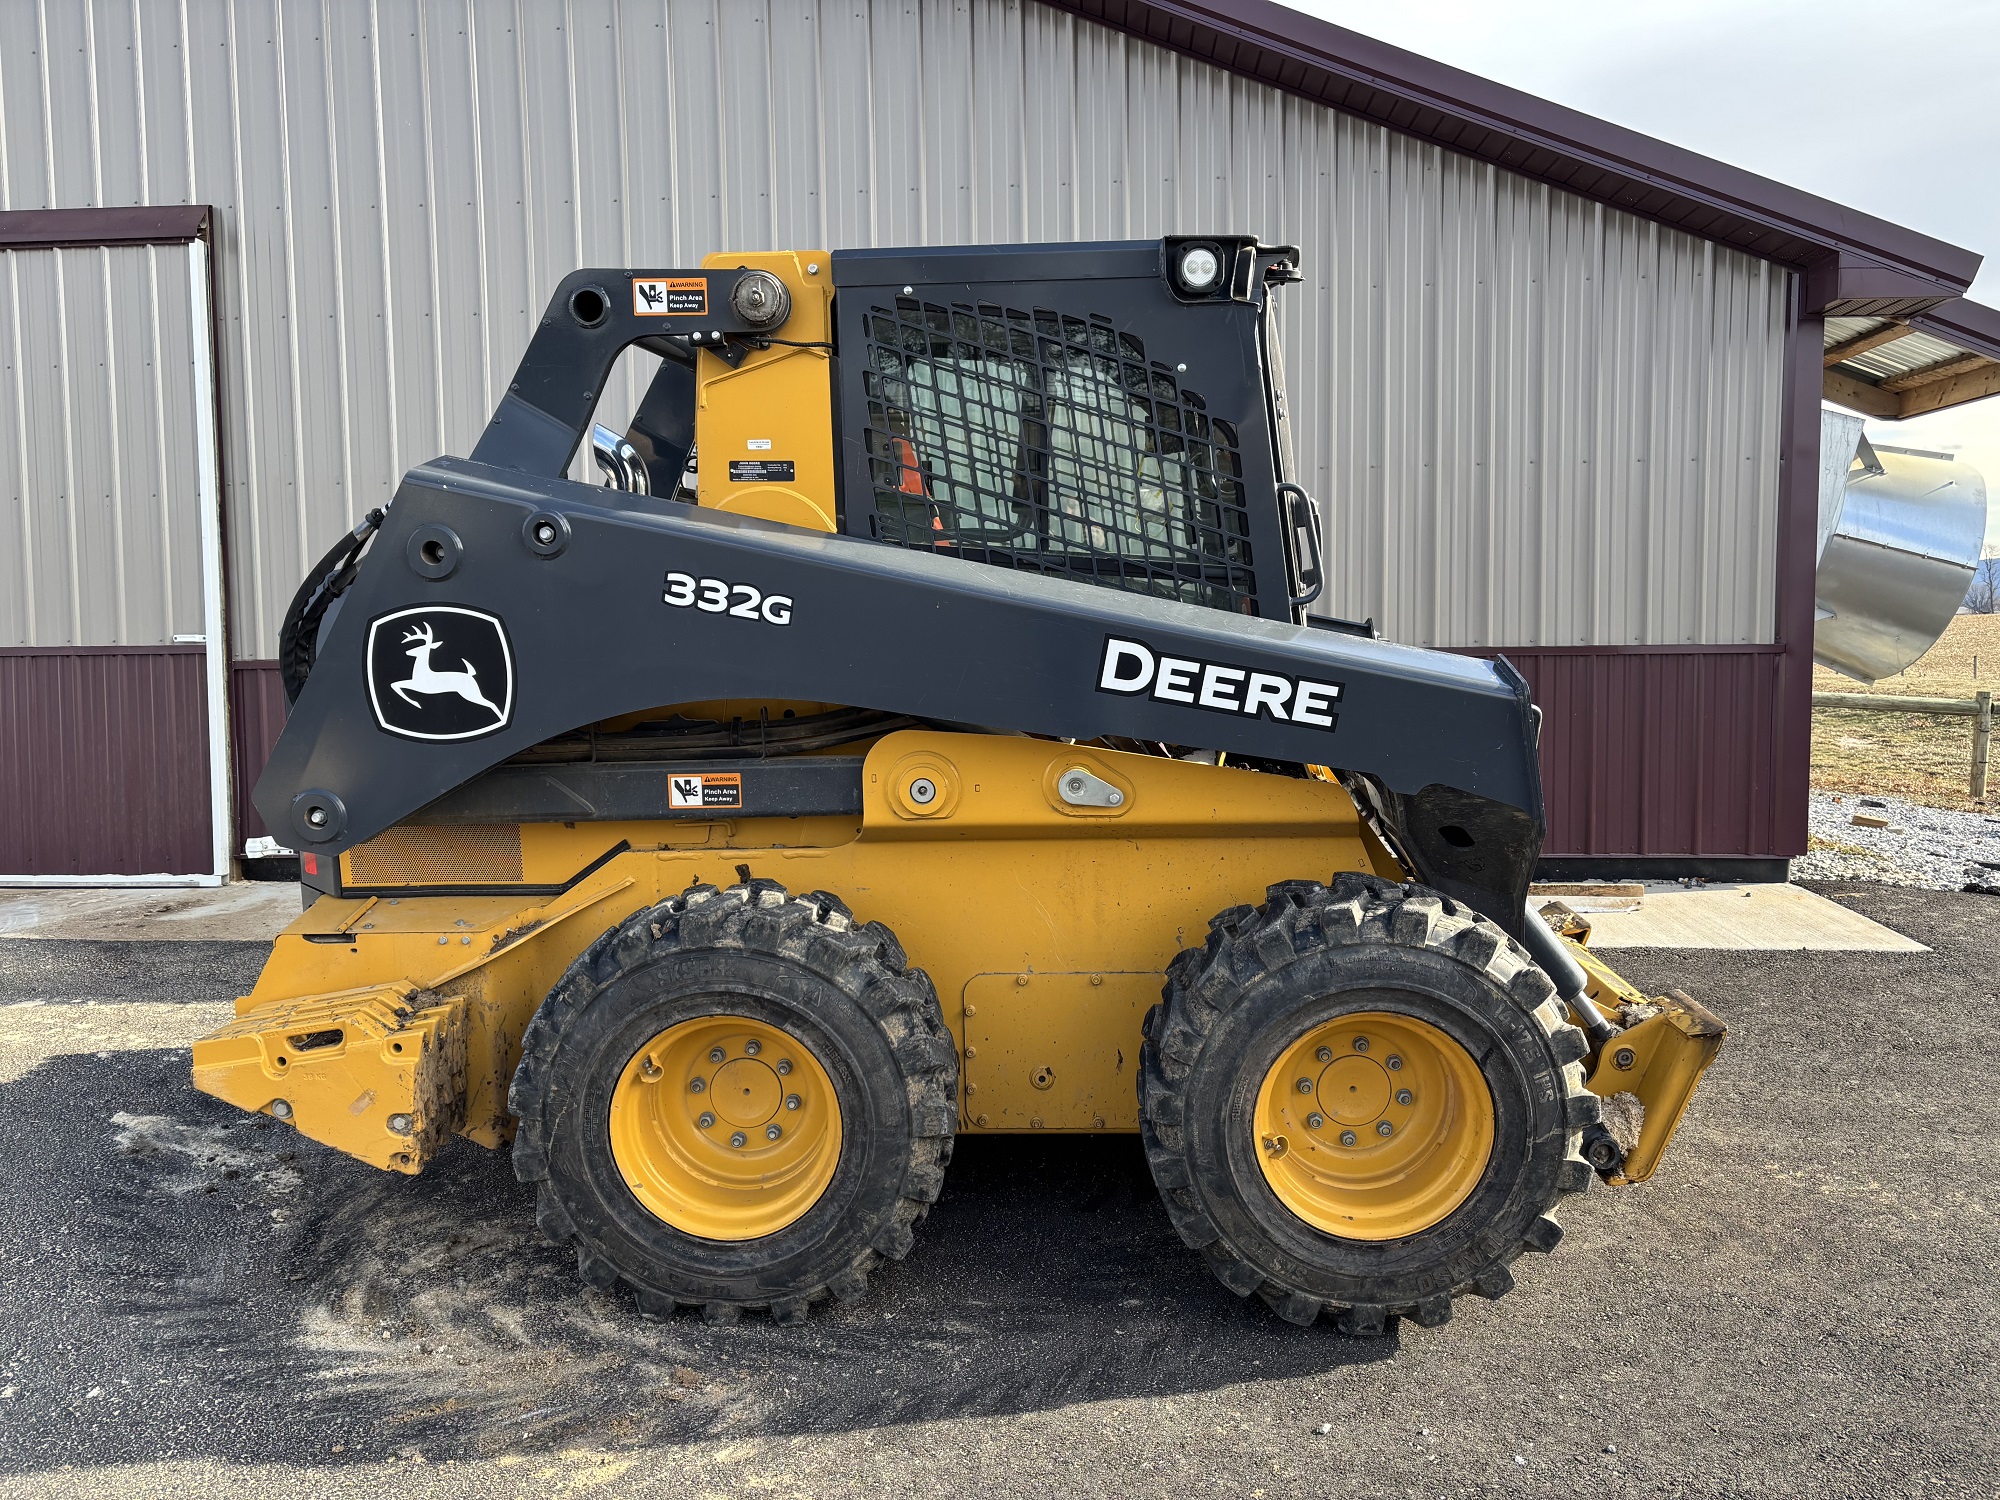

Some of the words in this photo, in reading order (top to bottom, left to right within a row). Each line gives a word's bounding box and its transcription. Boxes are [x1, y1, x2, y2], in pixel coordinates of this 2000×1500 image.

[664, 572, 793, 625] 332G
[1100, 638, 1340, 727] DEERE
[822, 1040, 852, 1084] TUBELESS
[1231, 1074, 1250, 1123] TUBELESS
[1416, 1234, 1504, 1294] CAMSO
